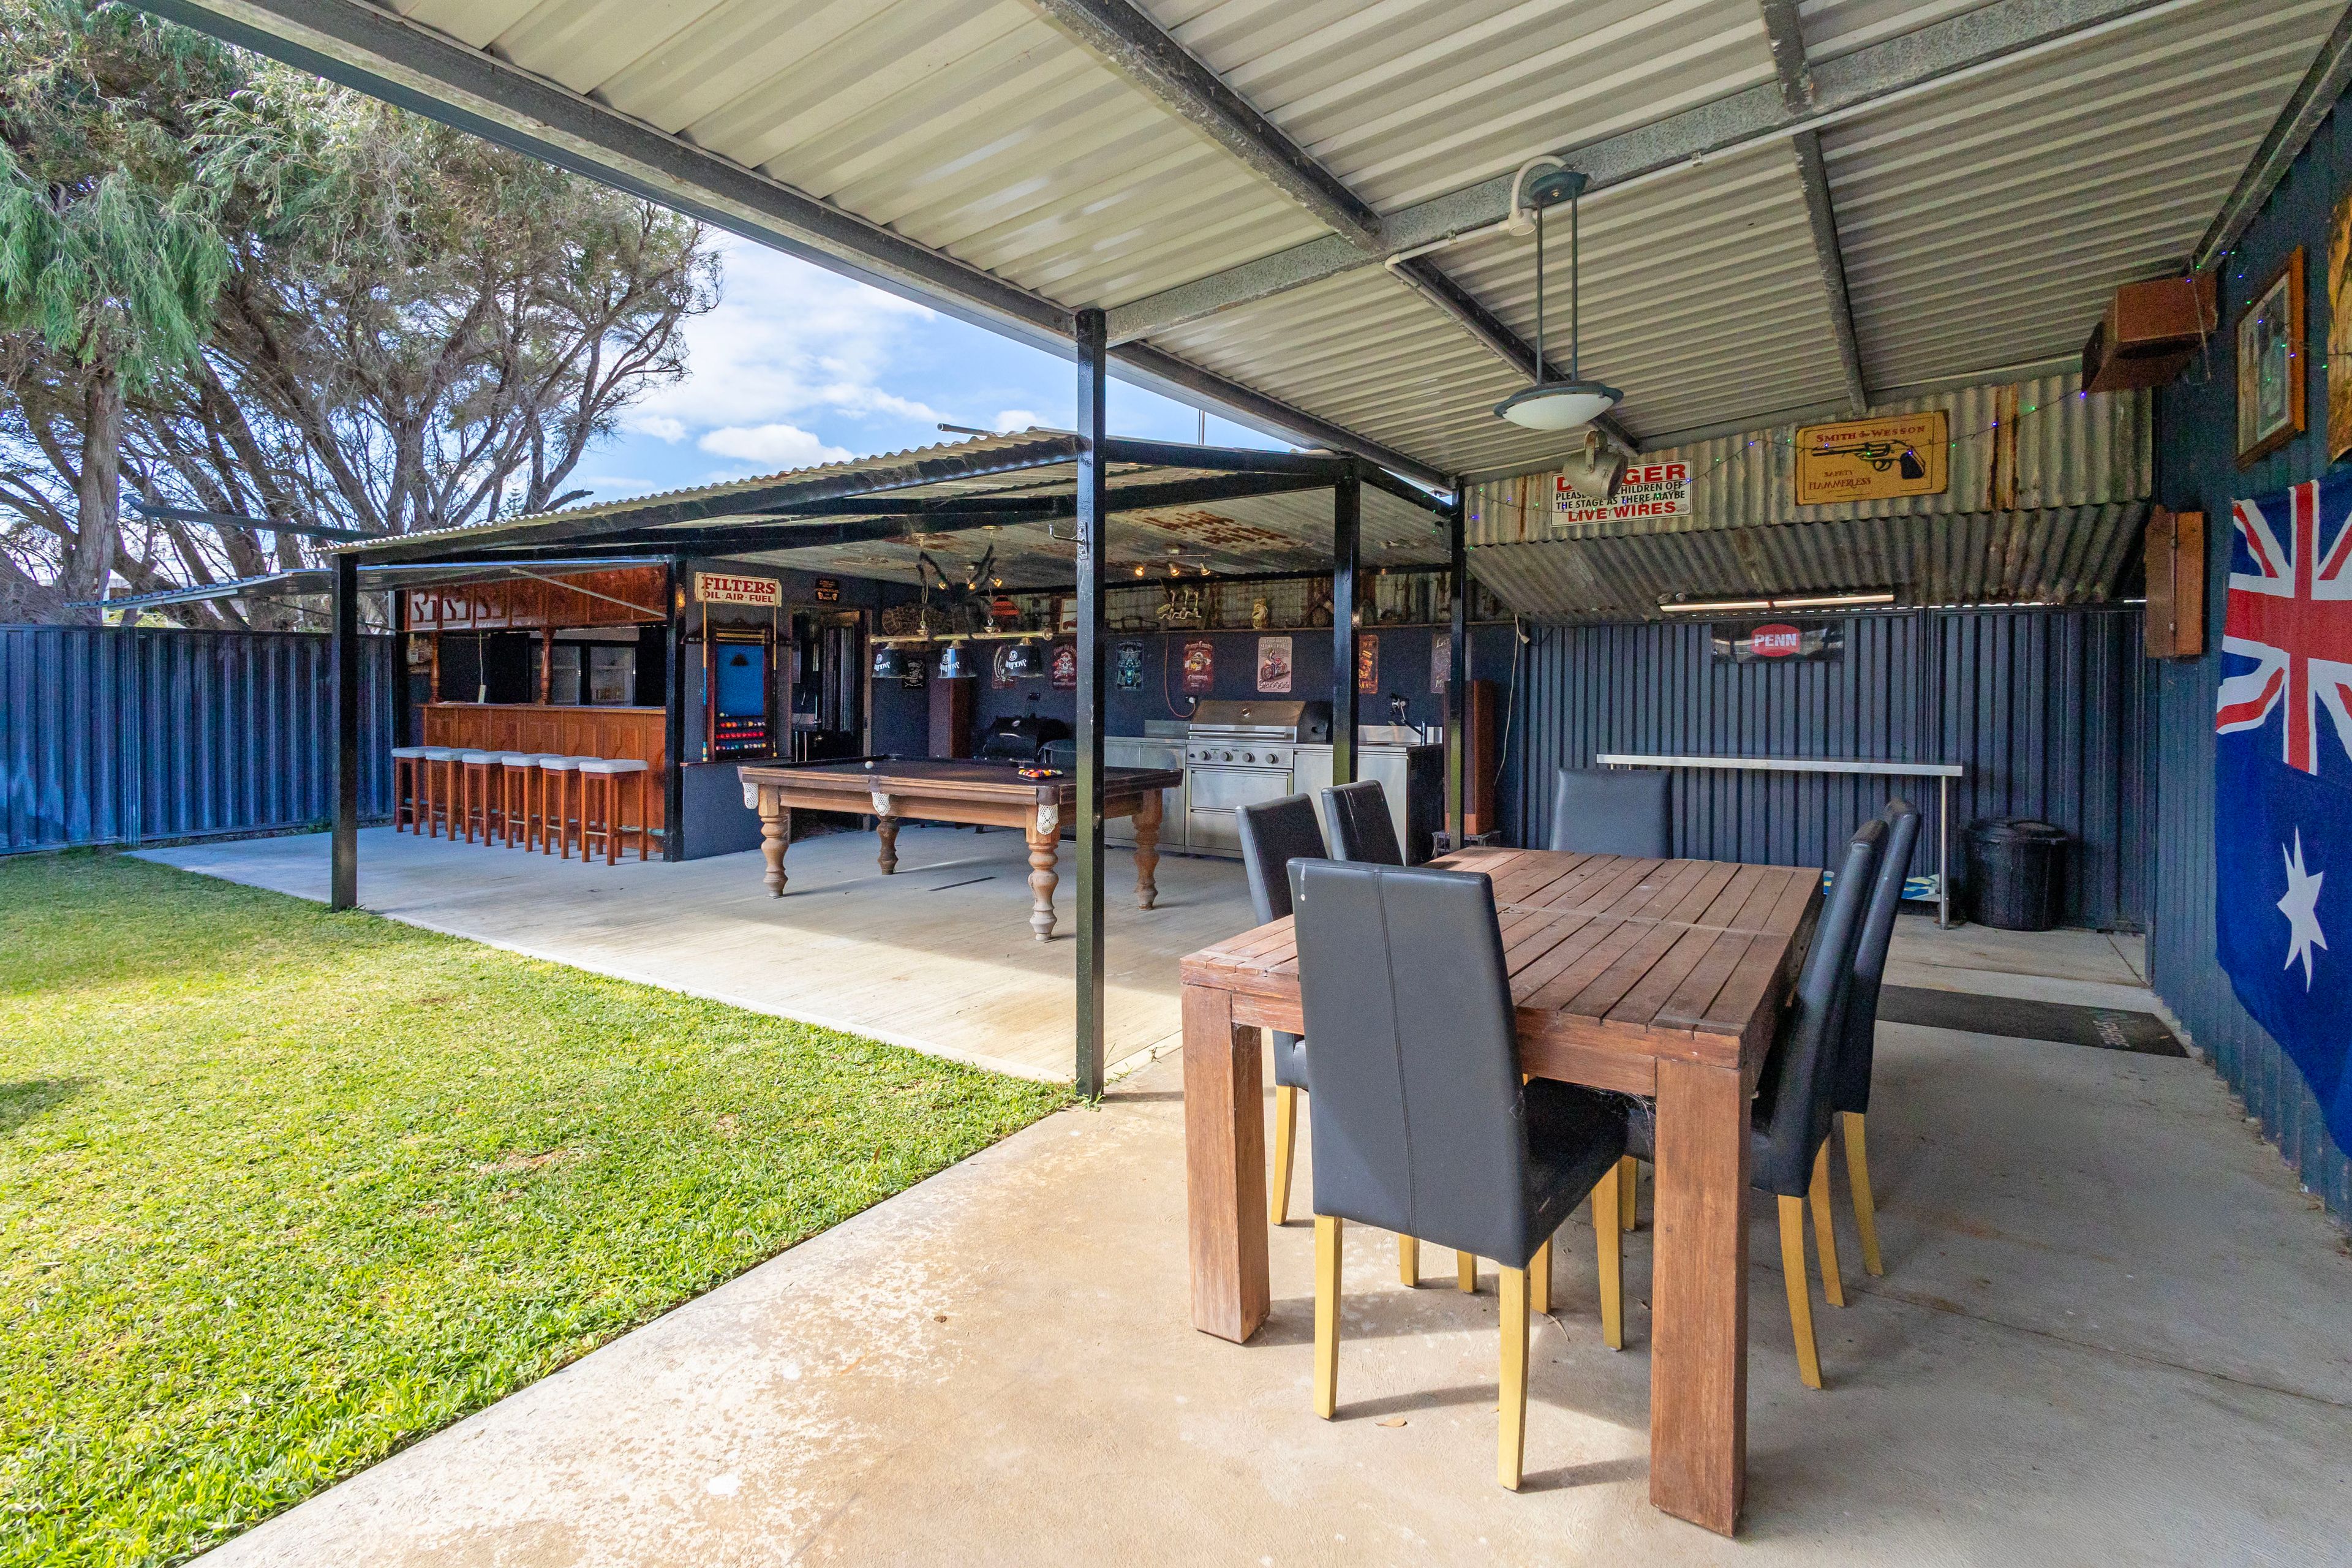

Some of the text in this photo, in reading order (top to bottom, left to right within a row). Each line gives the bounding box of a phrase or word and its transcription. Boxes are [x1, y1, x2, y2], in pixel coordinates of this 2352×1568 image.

[1816, 432, 1856, 442] SMITH
[1871, 426, 1926, 438] WESSON
[1556, 464, 1686, 491] DGER
[1665, 480, 1683, 491] OFF
[1809, 477, 1871, 489] HAMMERLESS
[1556, 490, 1686, 510] THE STAGE AS THERE MAYBE
[1568, 501, 1676, 522] LIVE WIRES
[701, 576, 776, 595] FILTERS
[749, 594, 774, 603] FUEL
[1754, 633, 1797, 647] PENN
